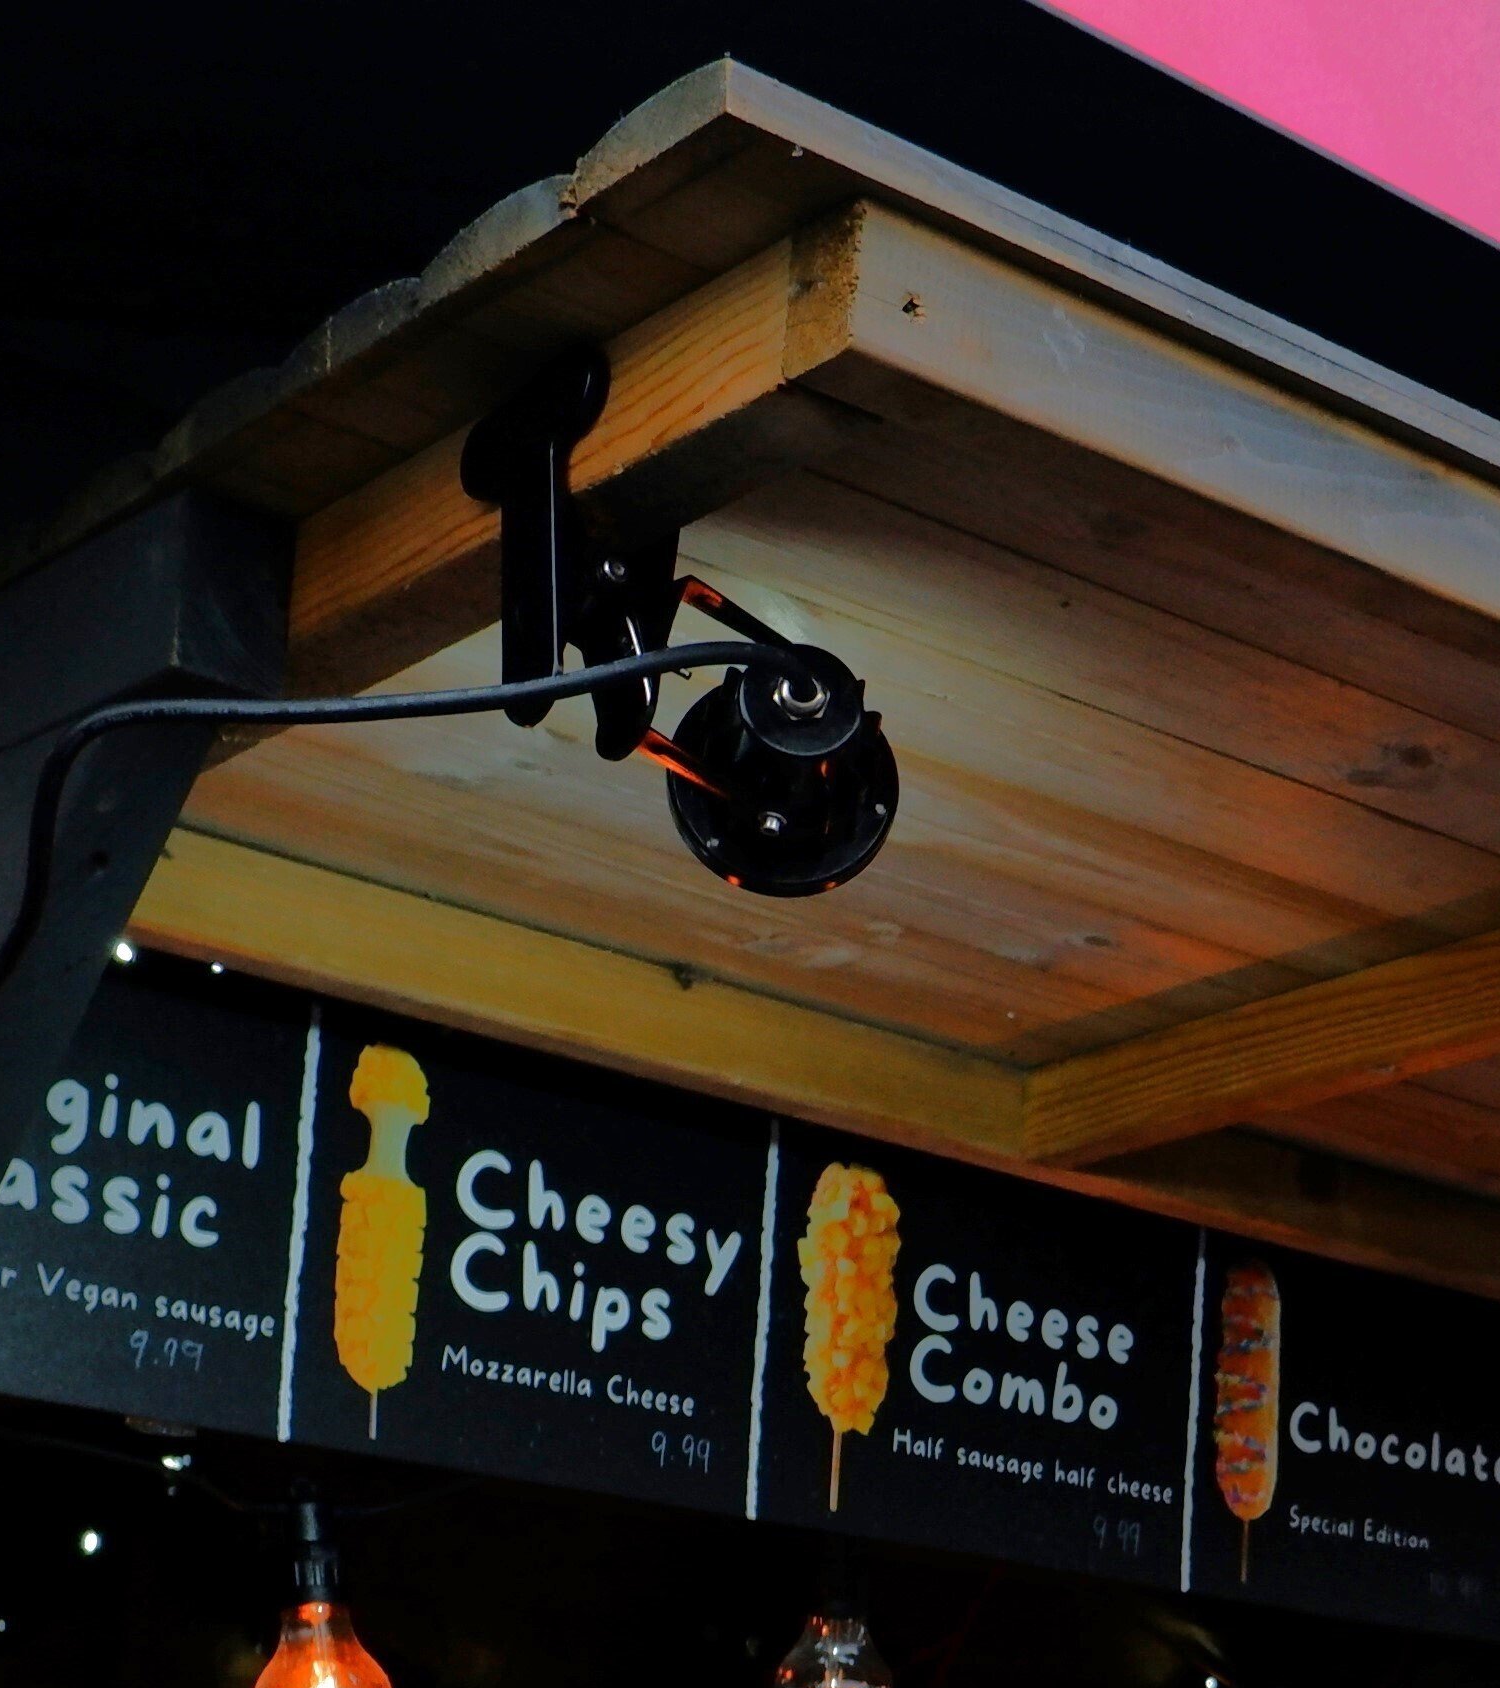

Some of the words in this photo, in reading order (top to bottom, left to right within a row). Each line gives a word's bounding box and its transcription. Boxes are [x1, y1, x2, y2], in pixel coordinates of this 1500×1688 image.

[455, 1149, 742, 1297] Cheesy
[37, 1262, 138, 1314] Vegan
[154, 1295, 276, 1341] sausage
[449, 1233, 673, 1353] Chips
[913, 1264, 1135, 1364] Cheese
[441, 1344, 593, 1399] Mozzarella
[606, 1374, 695, 1418] Cheese
[909, 1335, 1118, 1430] Combo
[652, 1430, 710, 1472] 9.99
[893, 1428, 943, 1461] Half
[957, 1440, 1042, 1484] sausage
[1054, 1456, 1097, 1490] half
[1108, 1469, 1174, 1504] cheese
[1289, 1504, 1354, 1540] Special
[1363, 1520, 1431, 1551] Edition
